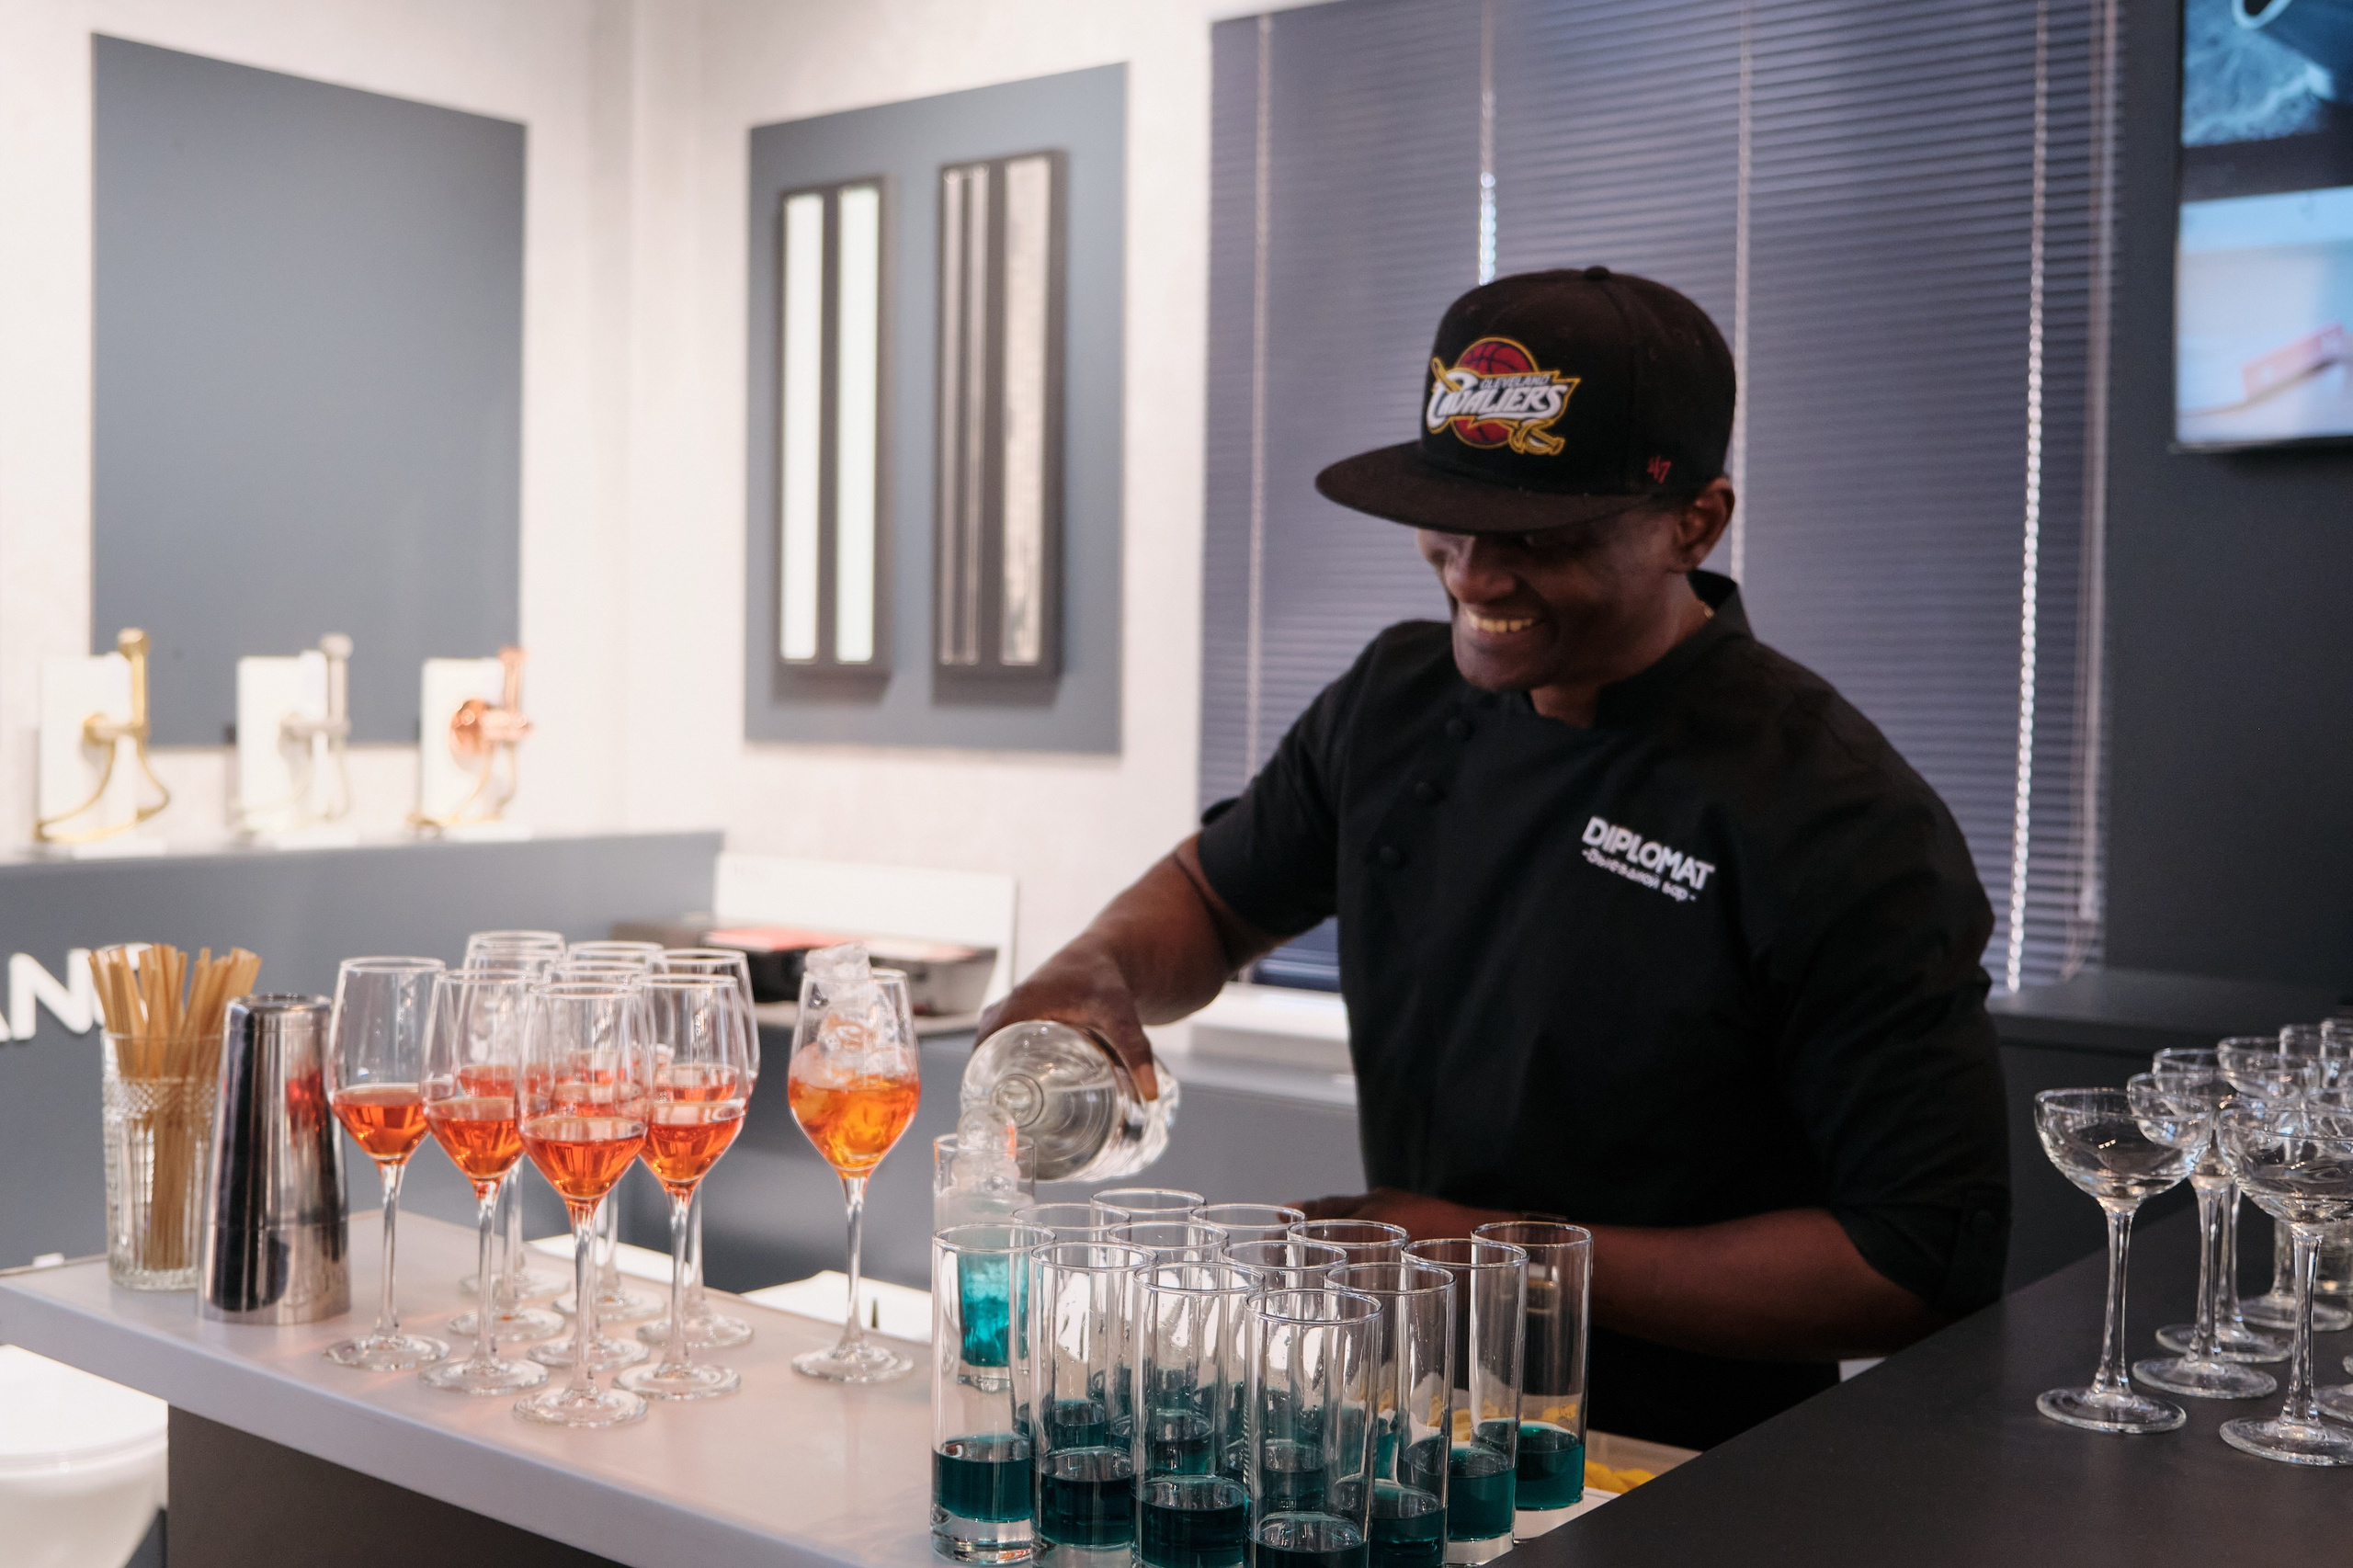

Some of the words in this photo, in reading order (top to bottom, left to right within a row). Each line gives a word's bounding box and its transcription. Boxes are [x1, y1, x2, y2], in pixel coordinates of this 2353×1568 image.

[1427, 370, 1568, 429] CAVALIERS
[1480, 374, 1551, 390] CLEVELAND
[1581, 815, 1716, 891] DIPLOMAT
